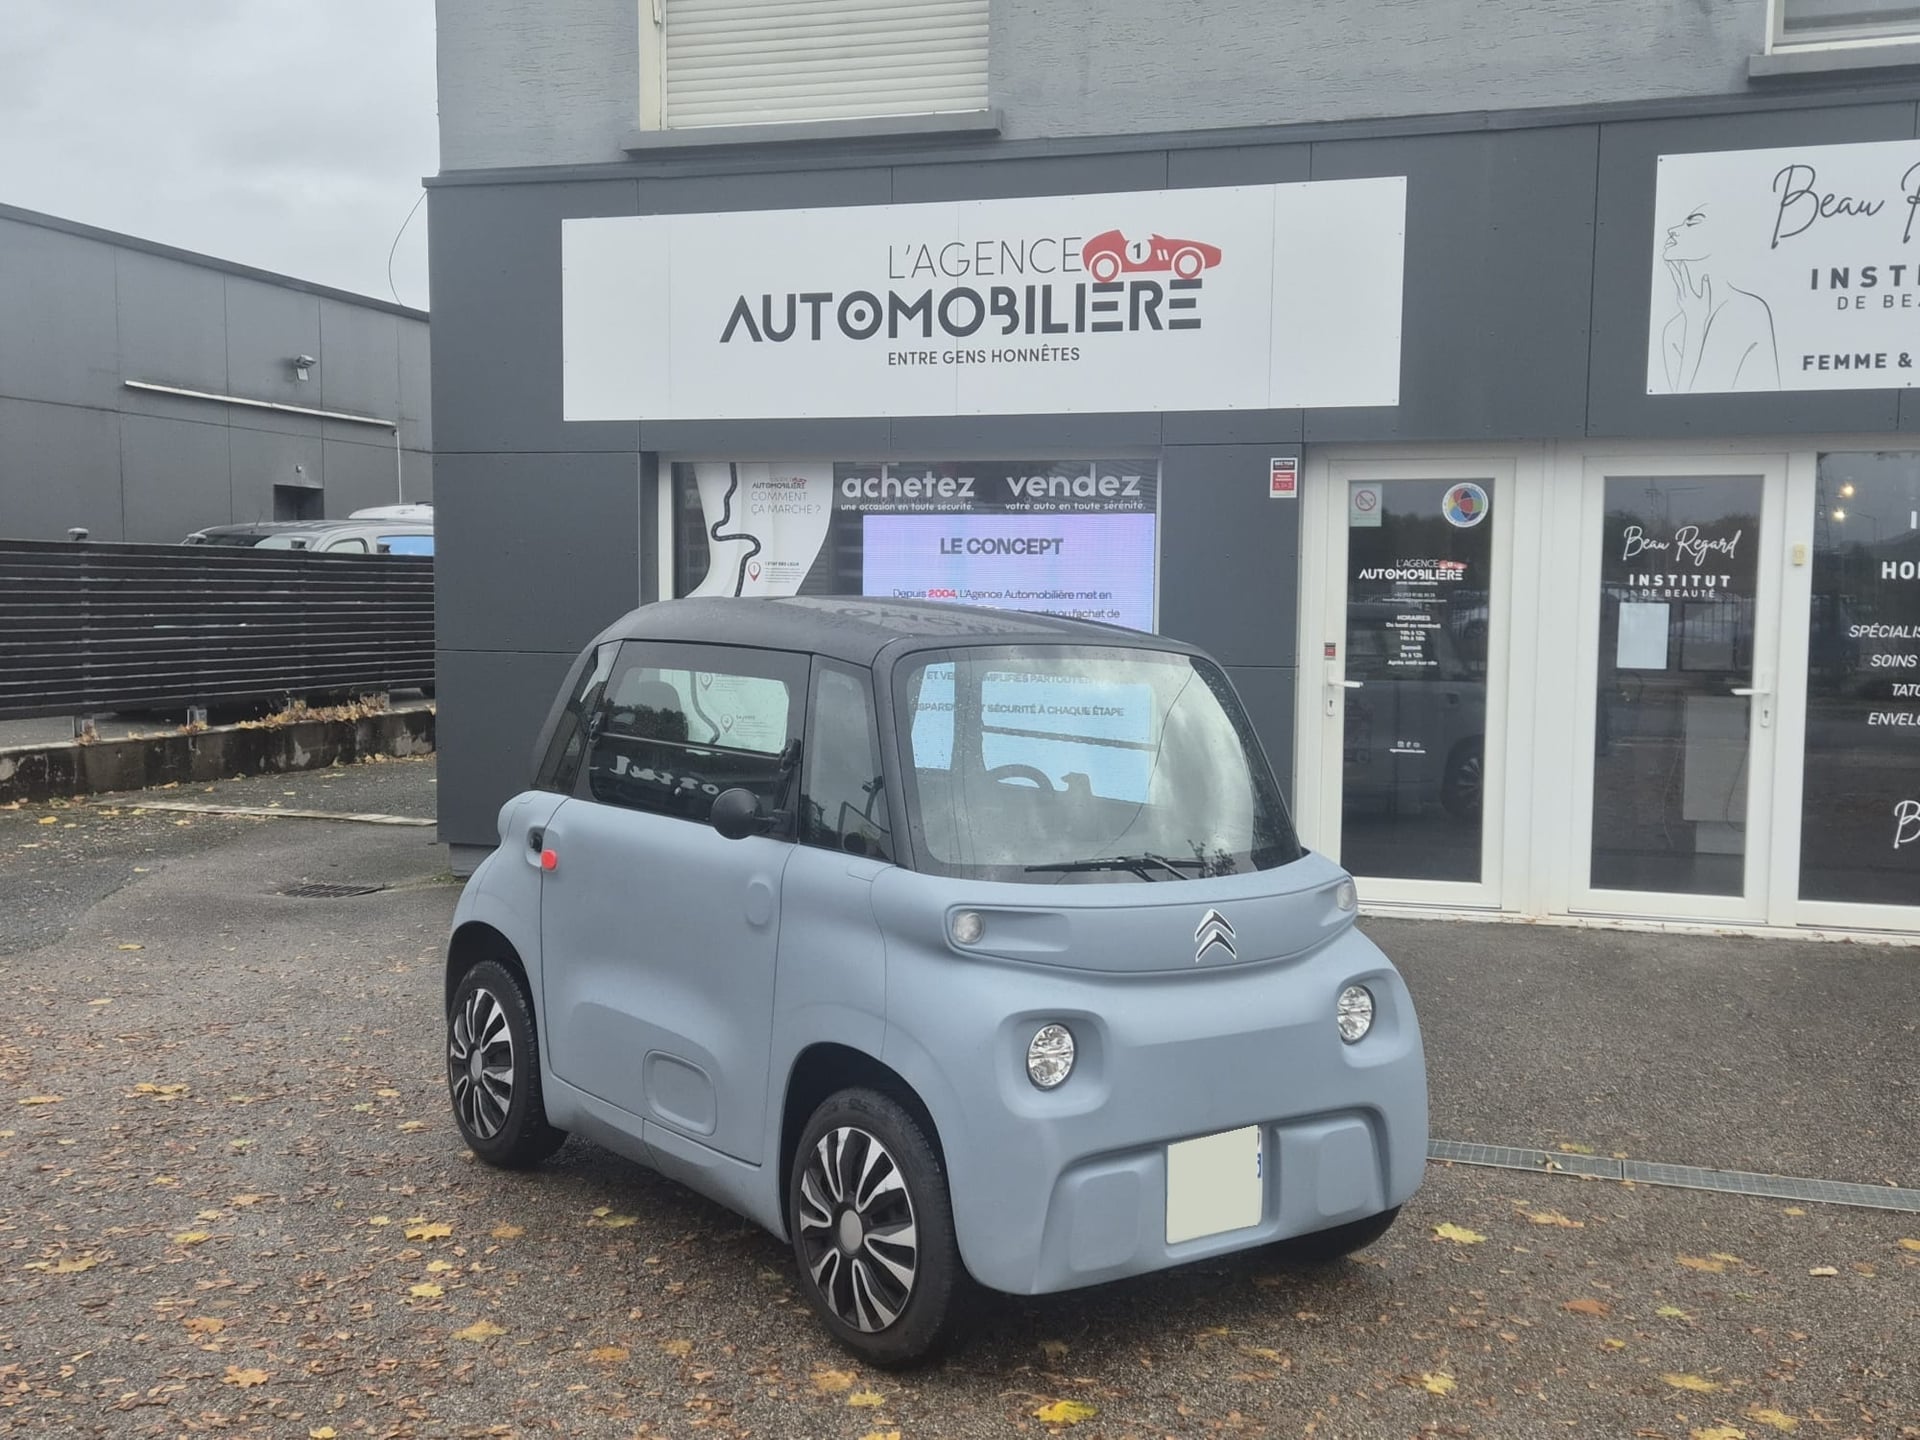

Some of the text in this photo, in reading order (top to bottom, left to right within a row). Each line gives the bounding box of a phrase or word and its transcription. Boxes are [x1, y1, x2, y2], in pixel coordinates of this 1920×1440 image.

[1771, 164, 1885, 249] Beau
[888, 236, 1083, 279] L'AGENCE
[1837, 293, 1920, 310] DE BE
[887, 343, 1081, 366] ENTRE GENS HONNÊTES
[1802, 352, 1913, 371] FEMME &
[841, 464, 976, 498] achetez
[1005, 462, 1142, 498] vendez
[751, 491, 808, 501] COMMENT
[751, 504, 765, 515] ÇA
[768, 504, 813, 514] MARCHE
[859, 501, 896, 511] occasion
[911, 502, 935, 511] toute
[1004, 502, 1031, 510] votre
[1033, 502, 1056, 510] auto
[1073, 501, 1100, 510] toute
[940, 537, 1064, 555] LE CONCEPT
[1622, 525, 1741, 566] Beau Regard
[1396, 559, 1439, 568] L'AGENCE
[1882, 561, 1920, 580] HO
[1629, 574, 1731, 587] INSTITUT
[893, 588, 927, 599] Depuis
[960, 588, 1003, 600] L'Agence
[1005, 588, 1075, 600] Automobilière
[1076, 590, 1098, 600] met
[1099, 591, 1113, 600] en
[1642, 588, 1716, 598] DE BEAUTÉ
[1106, 608, 1121, 618] de
[1870, 654, 1918, 668] SOINS
[987, 703, 1036, 714] SÉCURITÉ
[1047, 705, 1093, 717] CHAQUE
[1095, 704, 1124, 717] ÉTAPE
